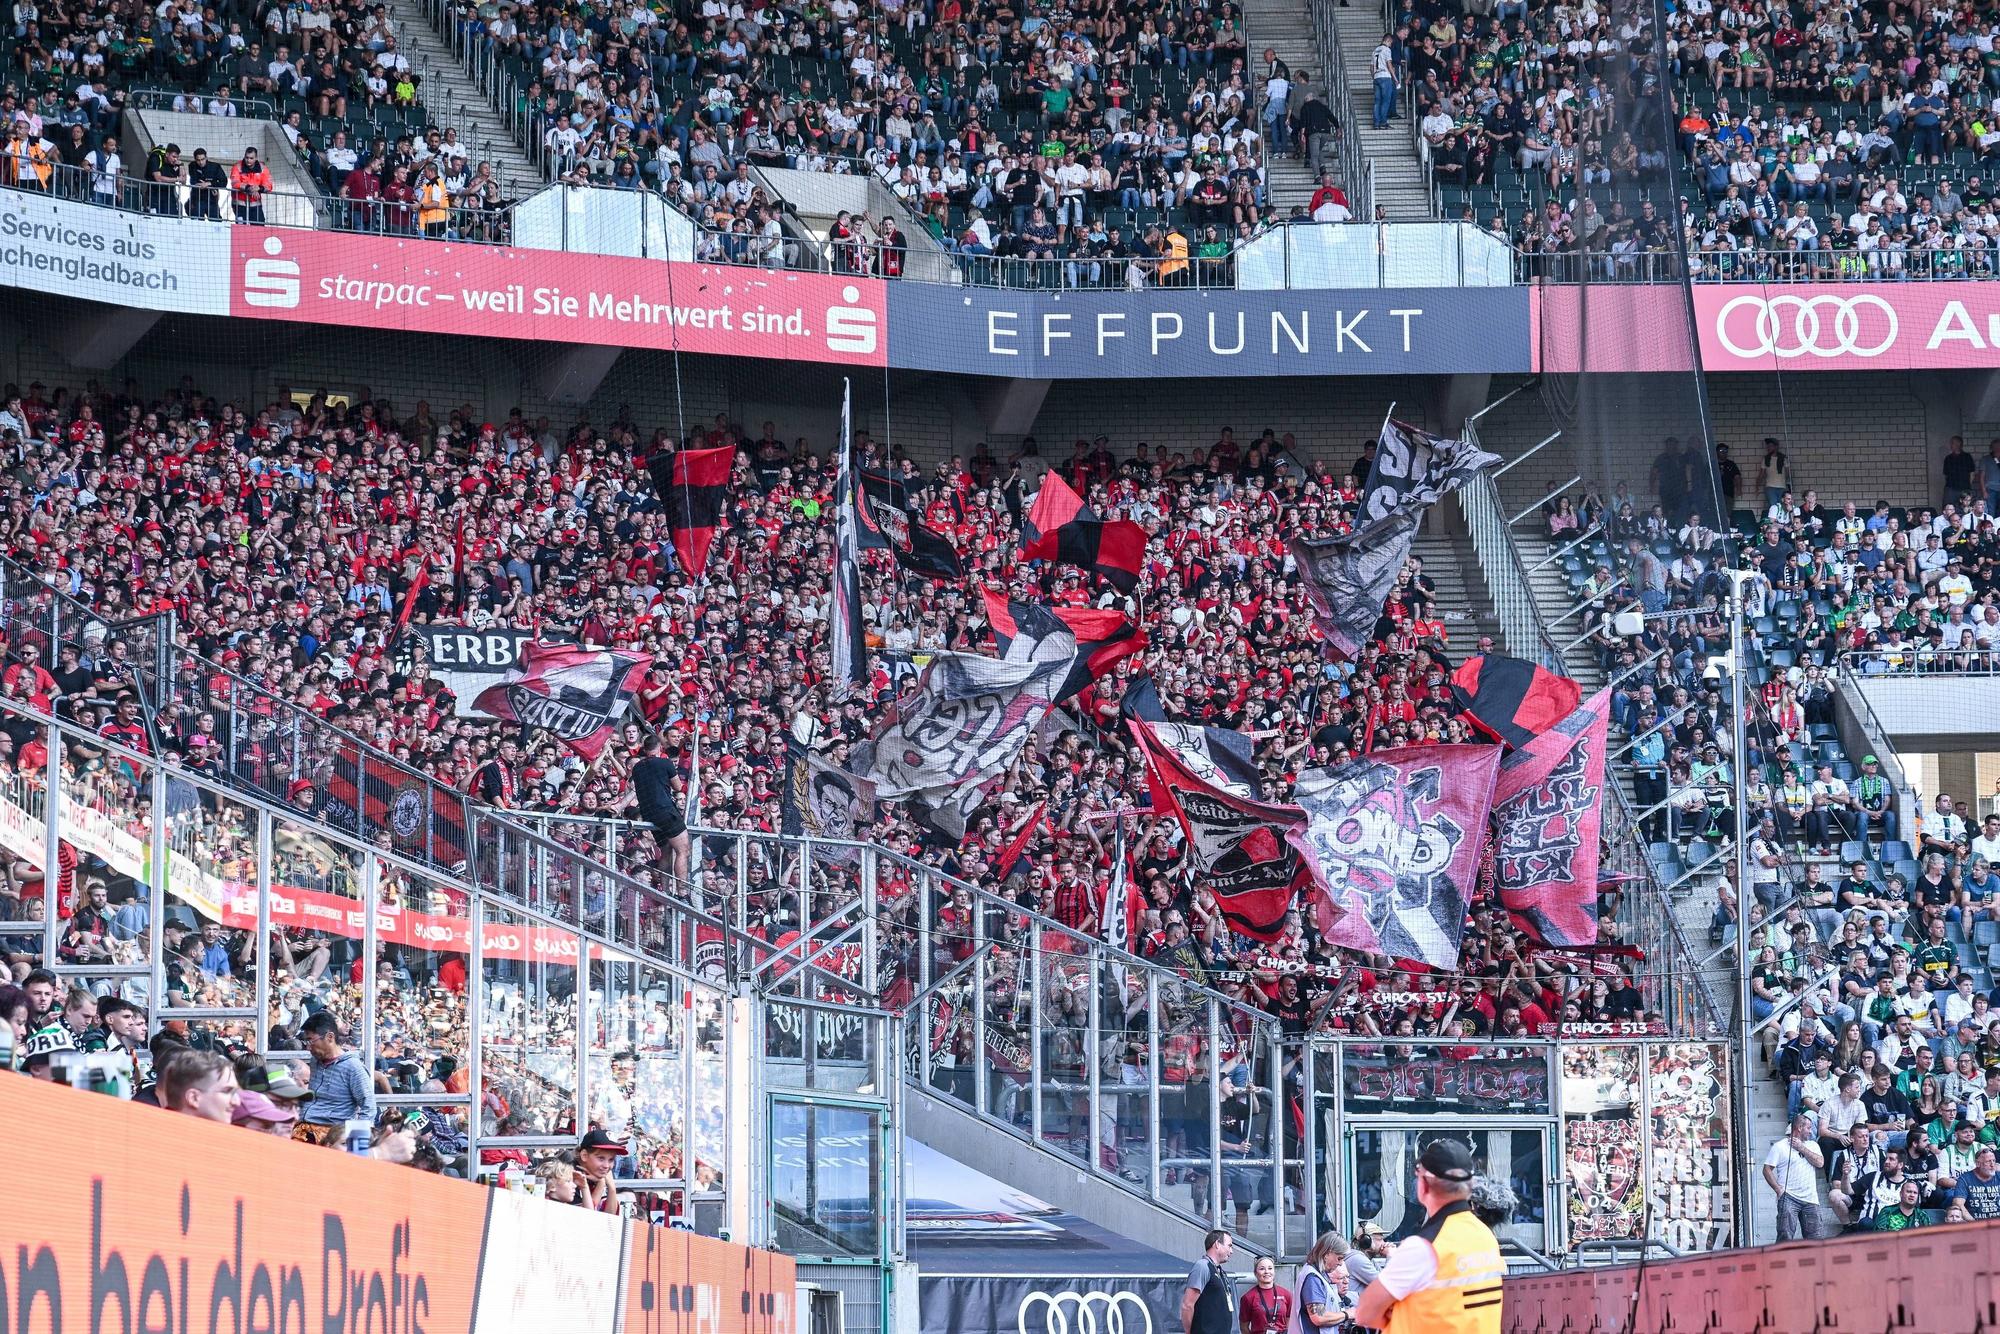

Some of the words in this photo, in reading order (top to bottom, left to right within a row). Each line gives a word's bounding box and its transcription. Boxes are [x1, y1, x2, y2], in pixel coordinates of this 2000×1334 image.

[2, 211, 105, 253] Services
[113, 236, 156, 260] aus
[0, 241, 178, 292] chengladbach
[318, 275, 432, 309] starpac
[462, 286, 524, 313] weil
[533, 287, 579, 317] Sie
[588, 291, 732, 330] Mehrwert
[741, 304, 811, 337] sind.
[988, 309, 1423, 355] EFFPUNKT
[1315, 965, 1342, 979] 513
[1373, 992, 1421, 1006] CHAOS
[1562, 1022, 1614, 1034] CHAOS
[1621, 1022, 1648, 1034] 513
[0, 1242, 63, 1334] n
[90, 1175, 191, 1334] bei
[207, 1196, 306, 1334] den
